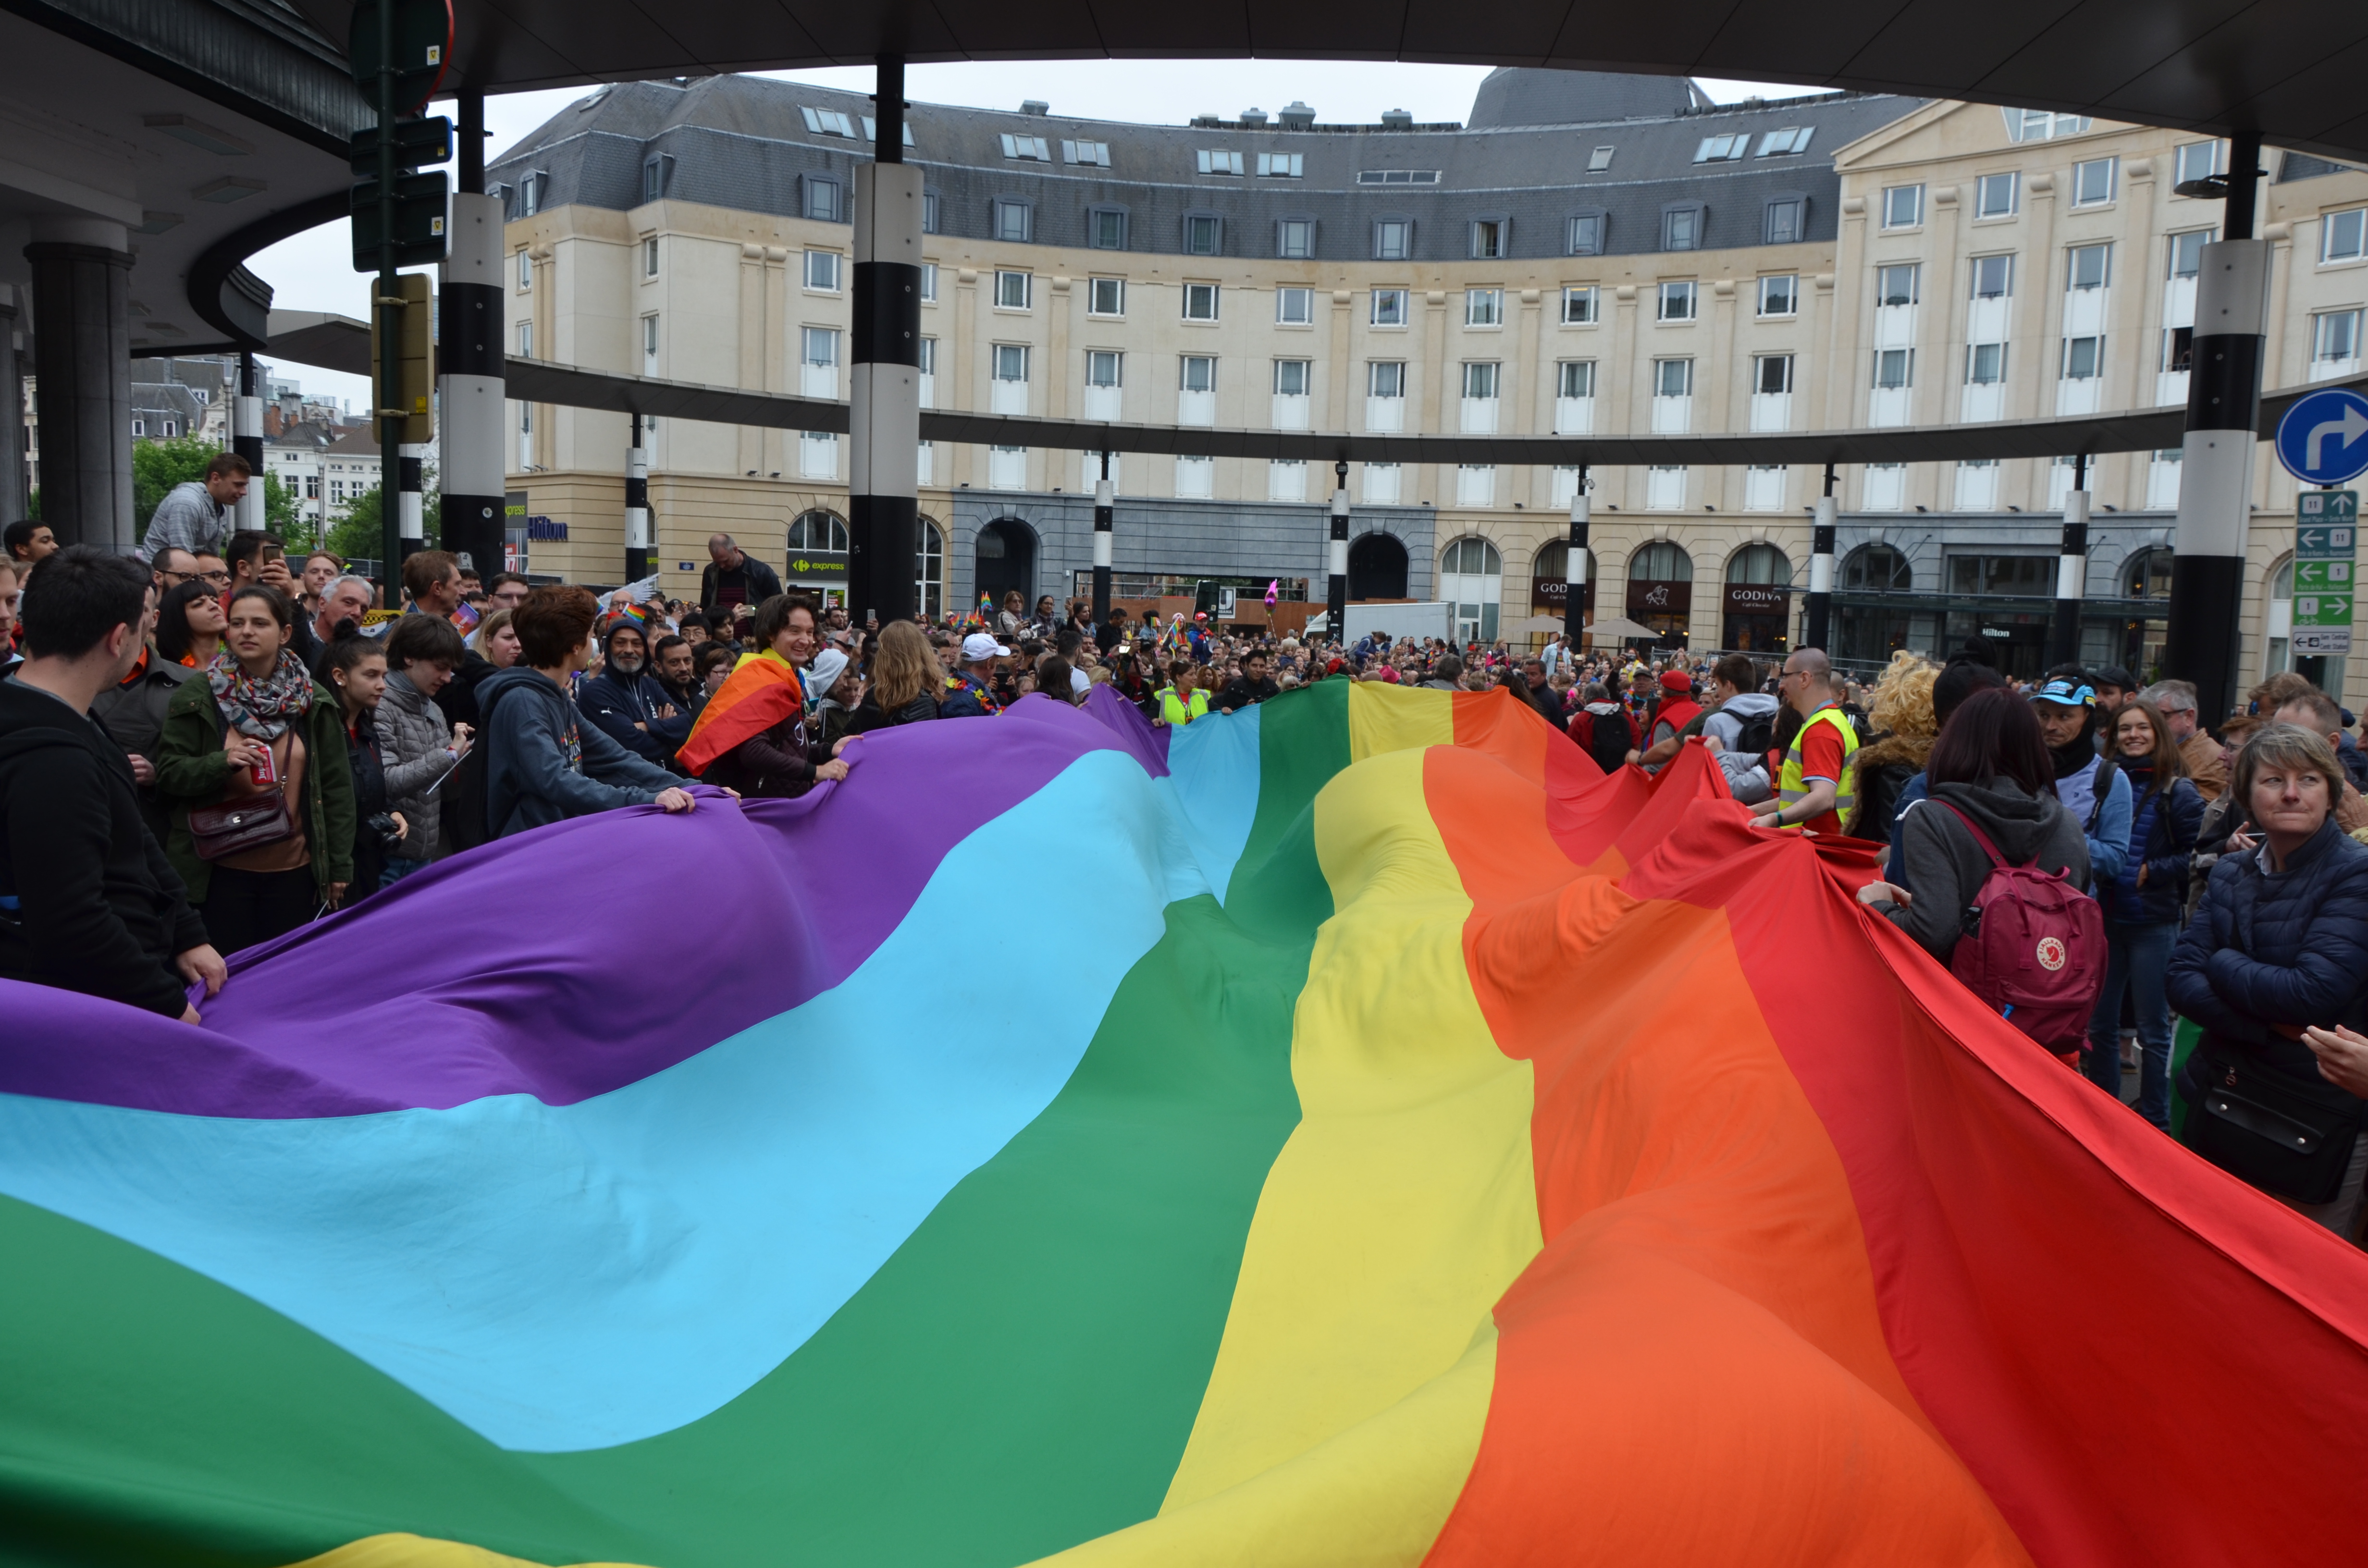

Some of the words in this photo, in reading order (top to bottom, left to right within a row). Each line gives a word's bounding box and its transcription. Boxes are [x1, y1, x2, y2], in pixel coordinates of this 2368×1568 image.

[505, 505, 525, 518] xpress
[528, 516, 567, 539] Hilton
[812, 563, 844, 571] express
[1541, 583, 1567, 593] GOD
[1732, 590, 1781, 600] GODIVA
[1983, 628, 2010, 637] Hilton
